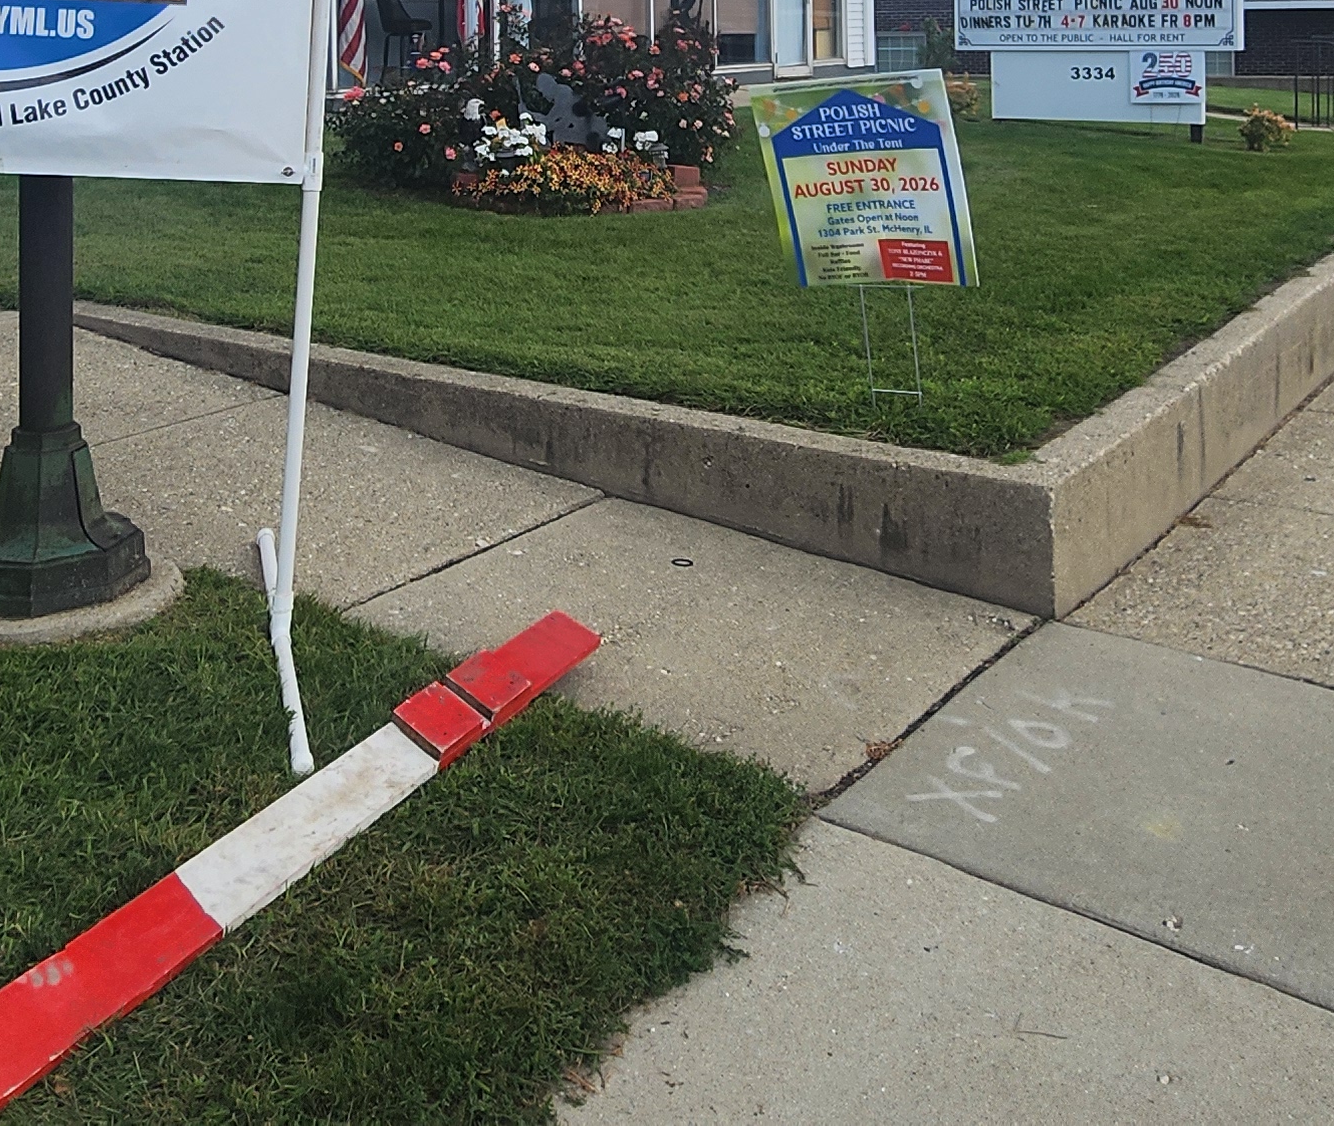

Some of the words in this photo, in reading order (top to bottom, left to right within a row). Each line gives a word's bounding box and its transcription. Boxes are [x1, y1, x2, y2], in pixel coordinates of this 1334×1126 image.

[960, 15, 1011, 29] DINNERS
[1060, 15, 1086, 29] 4-7
[1092, 13, 1156, 28] KARAOKE
[1160, 13, 1178, 28] FR
[999, 34, 1024, 43] OPEN
[1026, 34, 1038, 42] TO
[1040, 34, 1058, 42] THE
[1061, 34, 1094, 42] PUBLIC
[1109, 33, 1134, 42] HALL
[1137, 33, 1157, 42] FOR
[1159, 33, 1186, 42] RENT
[10, 98, 68, 125] Lake
[72, 65, 150, 111] County
[149, 16, 225, 76] Station
[1070, 66, 1116, 80] 3334
[1142, 52, 1192, 78] 250
[819, 103, 881, 122] POLISH
[791, 121, 854, 141] STREET
[861, 117, 917, 134] PICNIC
[813, 141, 850, 154] Under
[852, 139, 875, 151] The
[876, 138, 903, 149] Tent
[826, 157, 897, 176] SUNDAY
[794, 178, 866, 200] AUGUST
[870, 177, 895, 195] 30,
[898, 176, 940, 193] 2026
[826, 202, 854, 214] FREE
[856, 199, 916, 212] ENTRANCE
[827, 215, 855, 226] Gates
[856, 213, 883, 225] Open
[884, 212, 894, 222] at
[894, 211, 919, 222] Noon
[818, 228, 841, 238] 1304
[843, 226, 866, 236] Park
[867, 225, 880, 234] St.
[882, 224, 923, 235] McHenry,
[924, 224, 934, 234] IL
